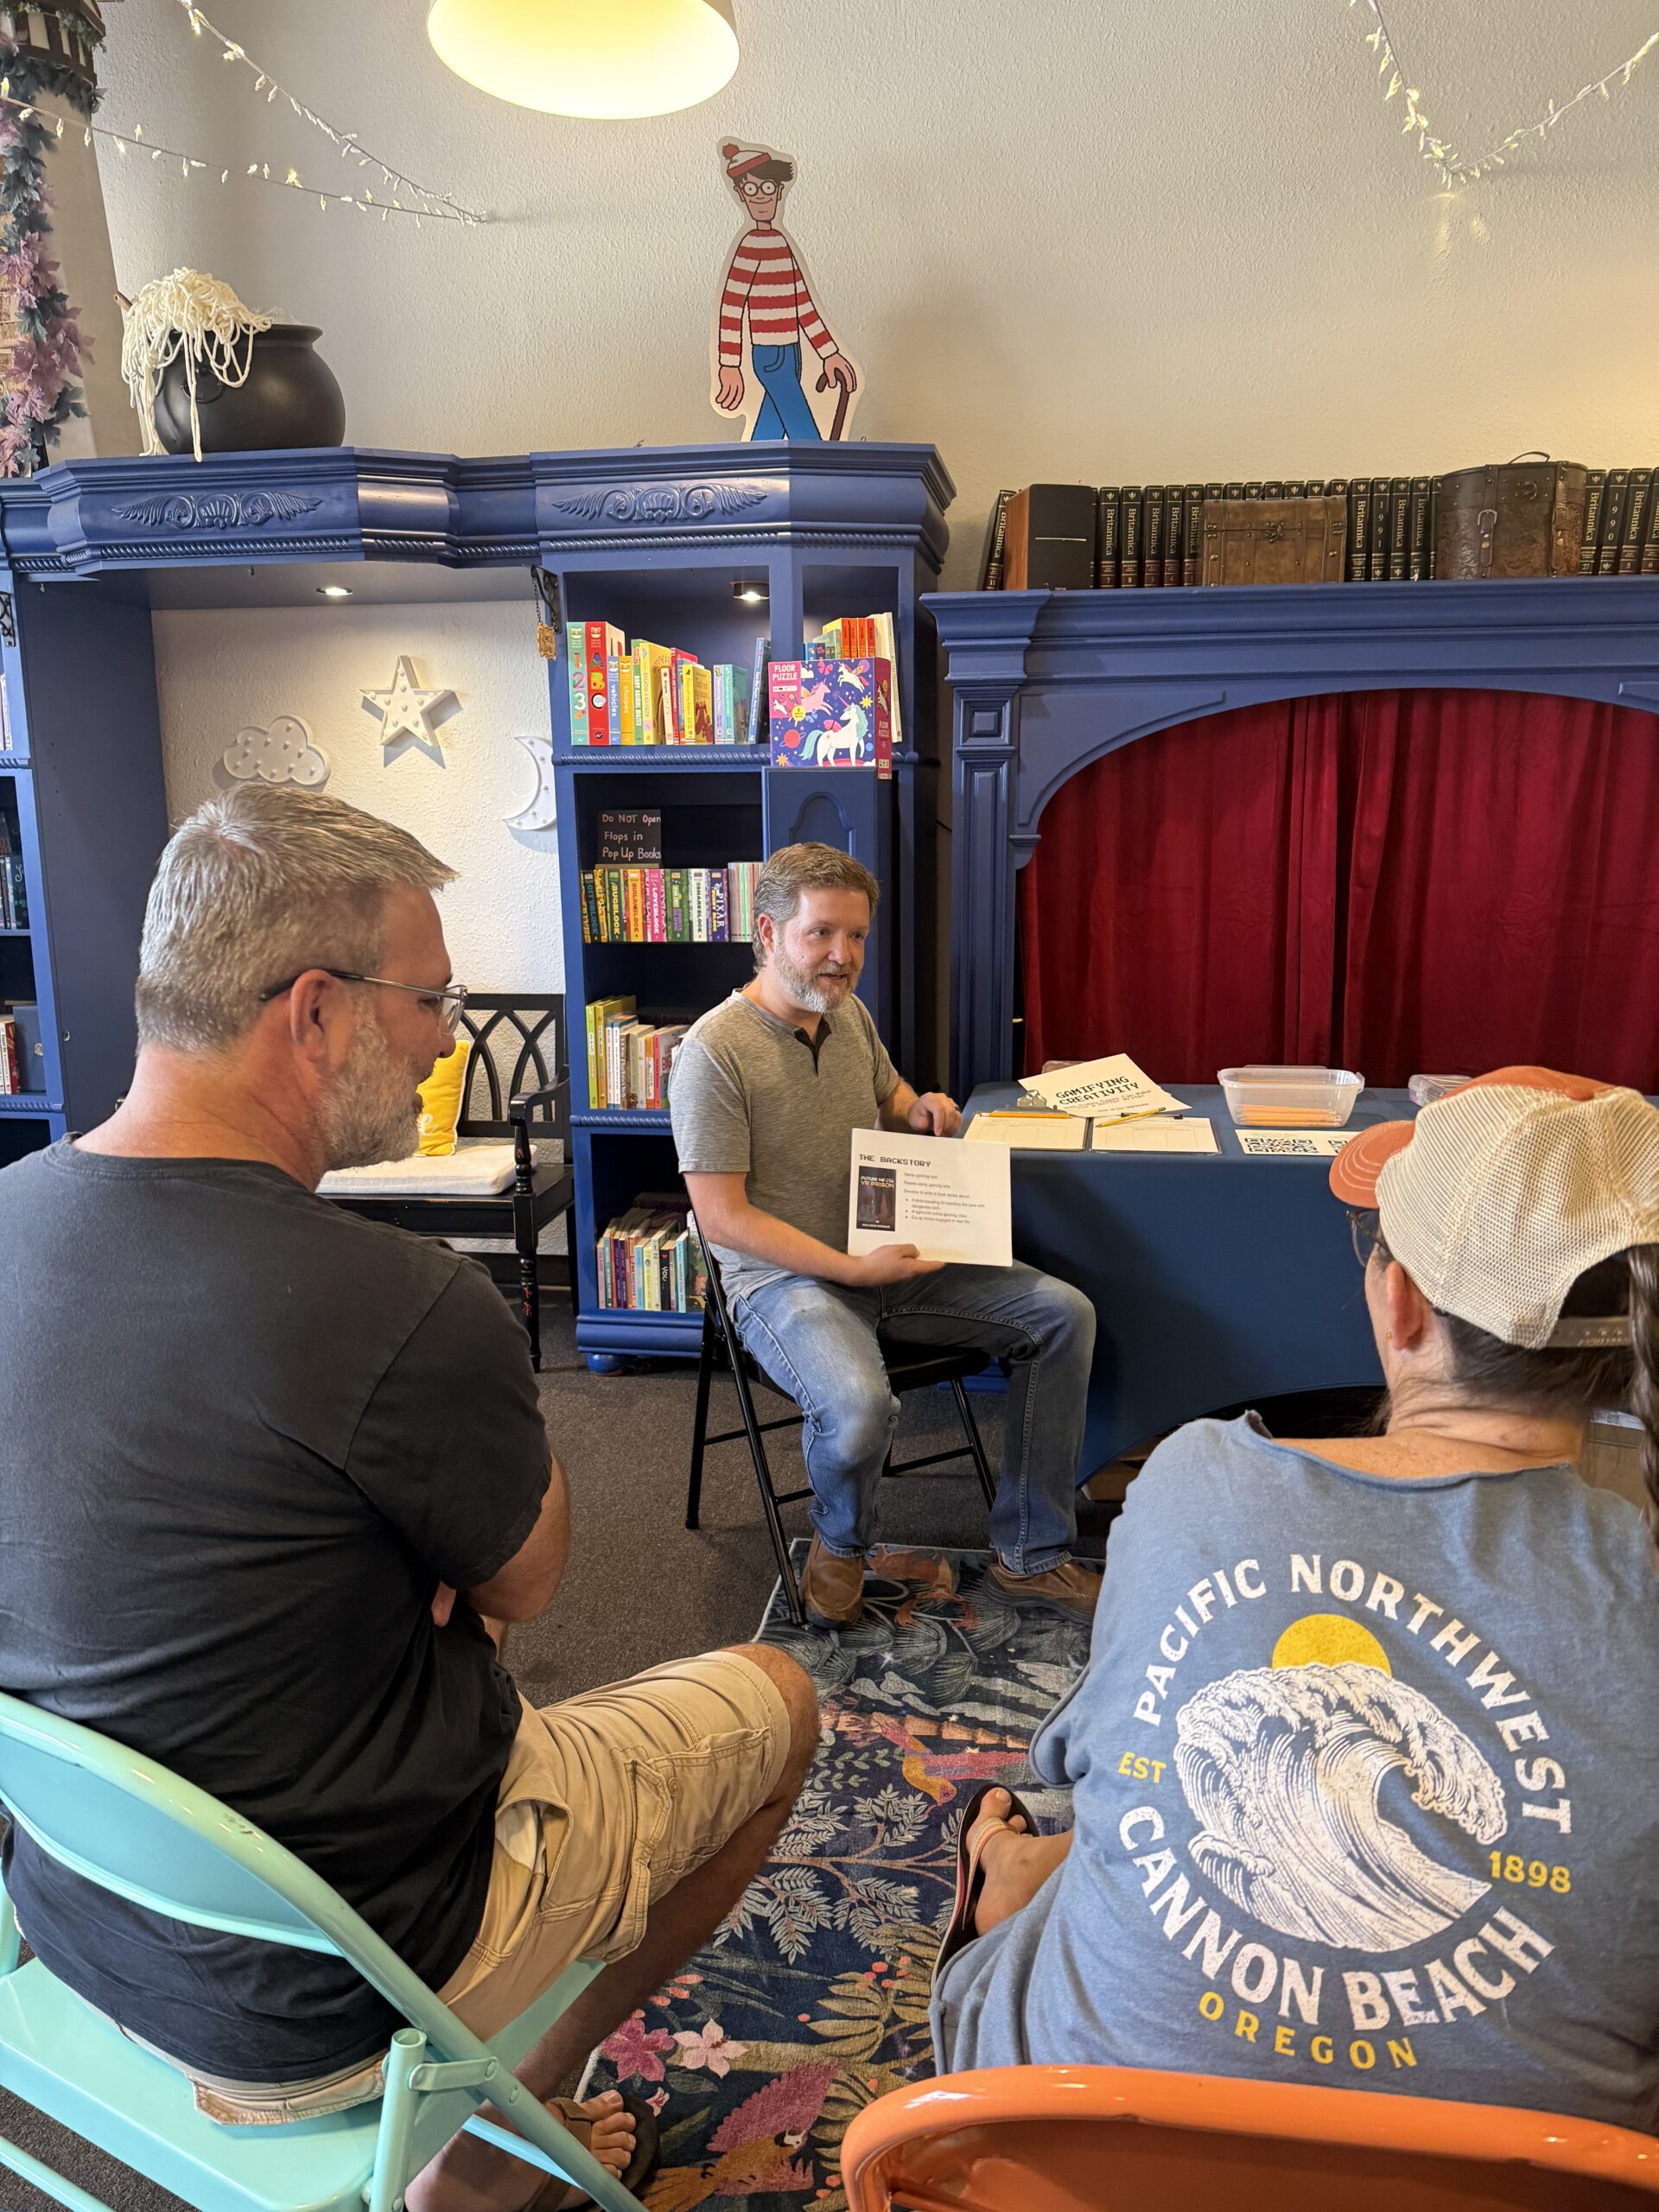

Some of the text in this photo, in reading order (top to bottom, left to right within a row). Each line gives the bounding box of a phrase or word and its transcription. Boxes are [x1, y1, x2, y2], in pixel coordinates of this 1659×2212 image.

[1106, 509, 1115, 556] Britannica
[1128, 508, 1136, 555] Britannica
[1151, 507, 1160, 554] Britannica
[1170, 507, 1179, 554] Britannica
[1190, 506, 1199, 553] Britannica
[1356, 500, 1366, 549] Britannica
[1396, 499, 1407, 547] Britannica
[1416, 499, 1427, 546] Britannica
[1586, 492, 1599, 541] Britannica
[1630, 491, 1644, 539] Britannica
[772, 672, 798, 681] PUZZLE
[610, 684, 619, 717] vehicles
[601, 814, 661, 826] Do NOT Open
[604, 831, 644, 843] Flaps in
[602, 847, 662, 861] Pop Up Books
[588, 884, 599, 933] CITYBLOCK
[612, 885, 620, 935] BUGBLOCK
[716, 893, 725, 927] PIXAR
[1056, 1076, 1129, 1098] GAMIFYING
[1059, 1082, 1139, 1105] CREATIVITY
[859, 1154, 931, 1167] THE BACKSTORY
[1133, 1554, 1572, 1834] PACIFIC NORTHWEST
[1117, 1751, 1166, 1783] EST
[1489, 1852, 1572, 1894] 1898
[1119, 1805, 1555, 2031] CANNON BEACH
[1198, 1991, 1419, 2070] OREGON
